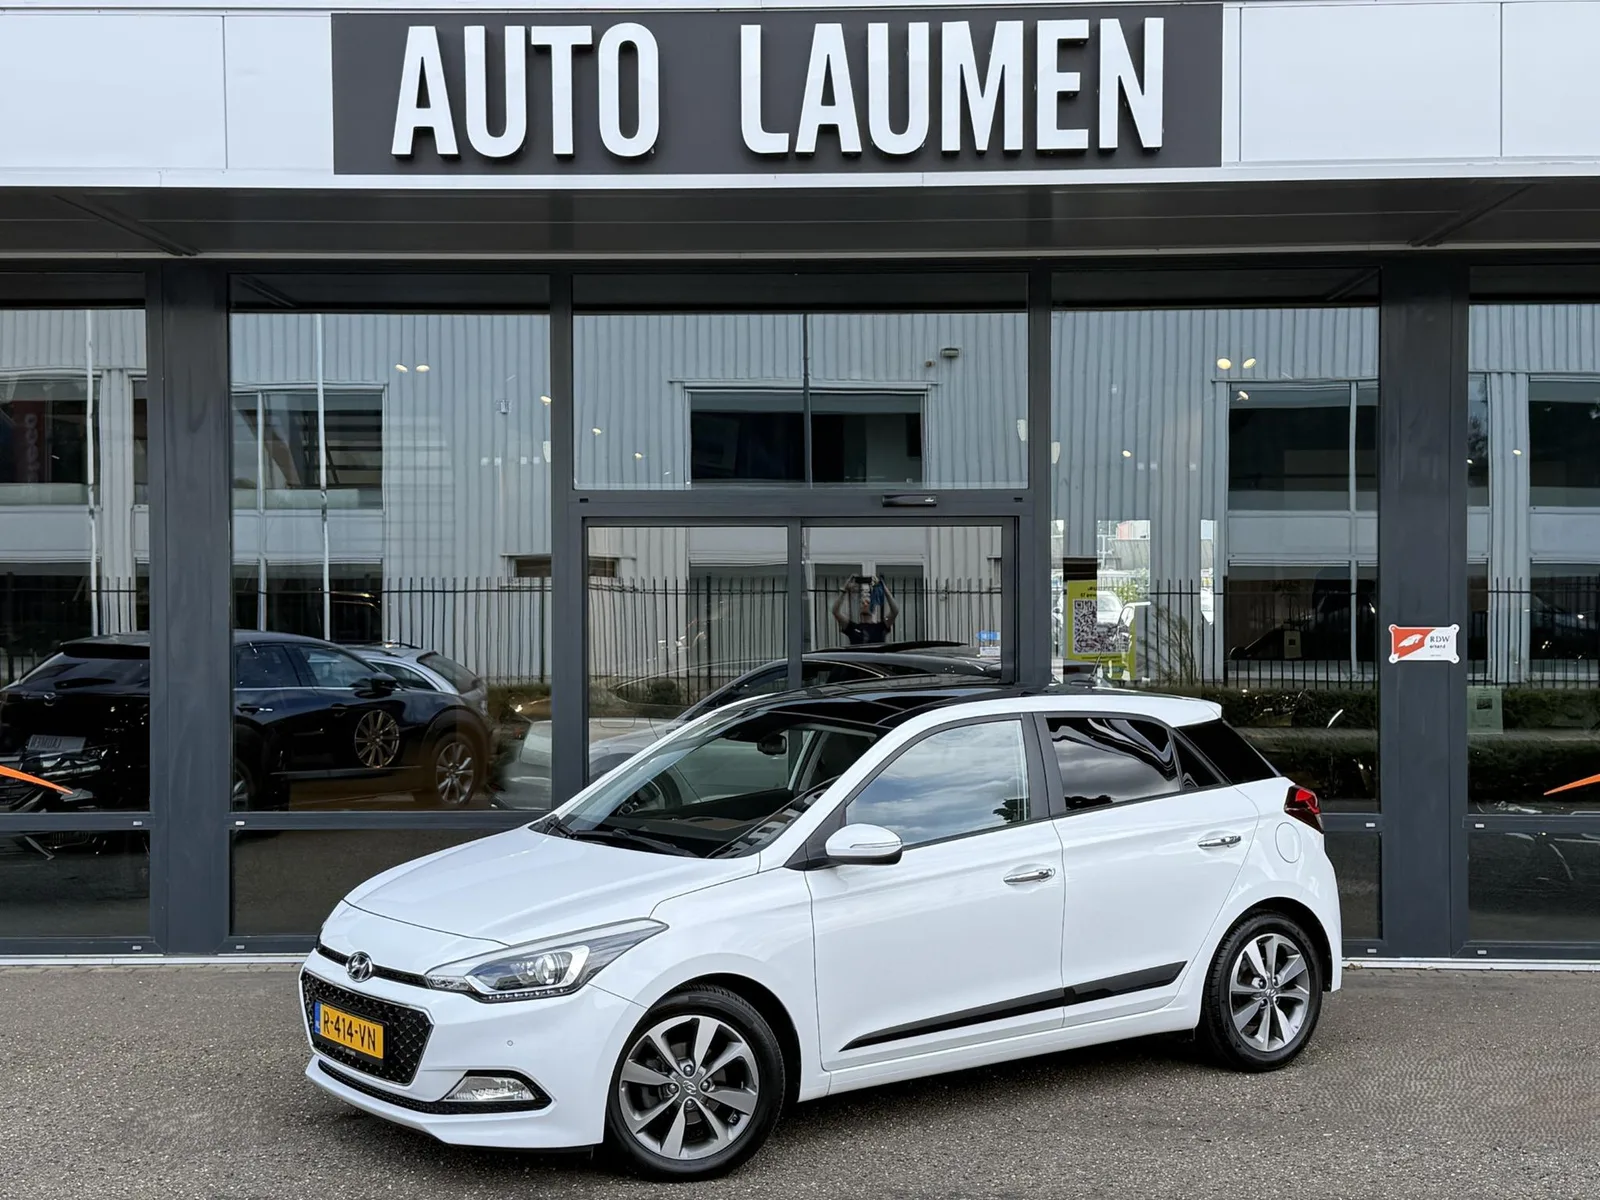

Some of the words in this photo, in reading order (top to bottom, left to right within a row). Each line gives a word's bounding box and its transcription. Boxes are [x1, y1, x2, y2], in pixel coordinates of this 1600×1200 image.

[391, 22, 660, 158] AUTO
[740, 17, 1165, 155] LAUMEN
[323, 1010, 376, 1052] R-414-VN
